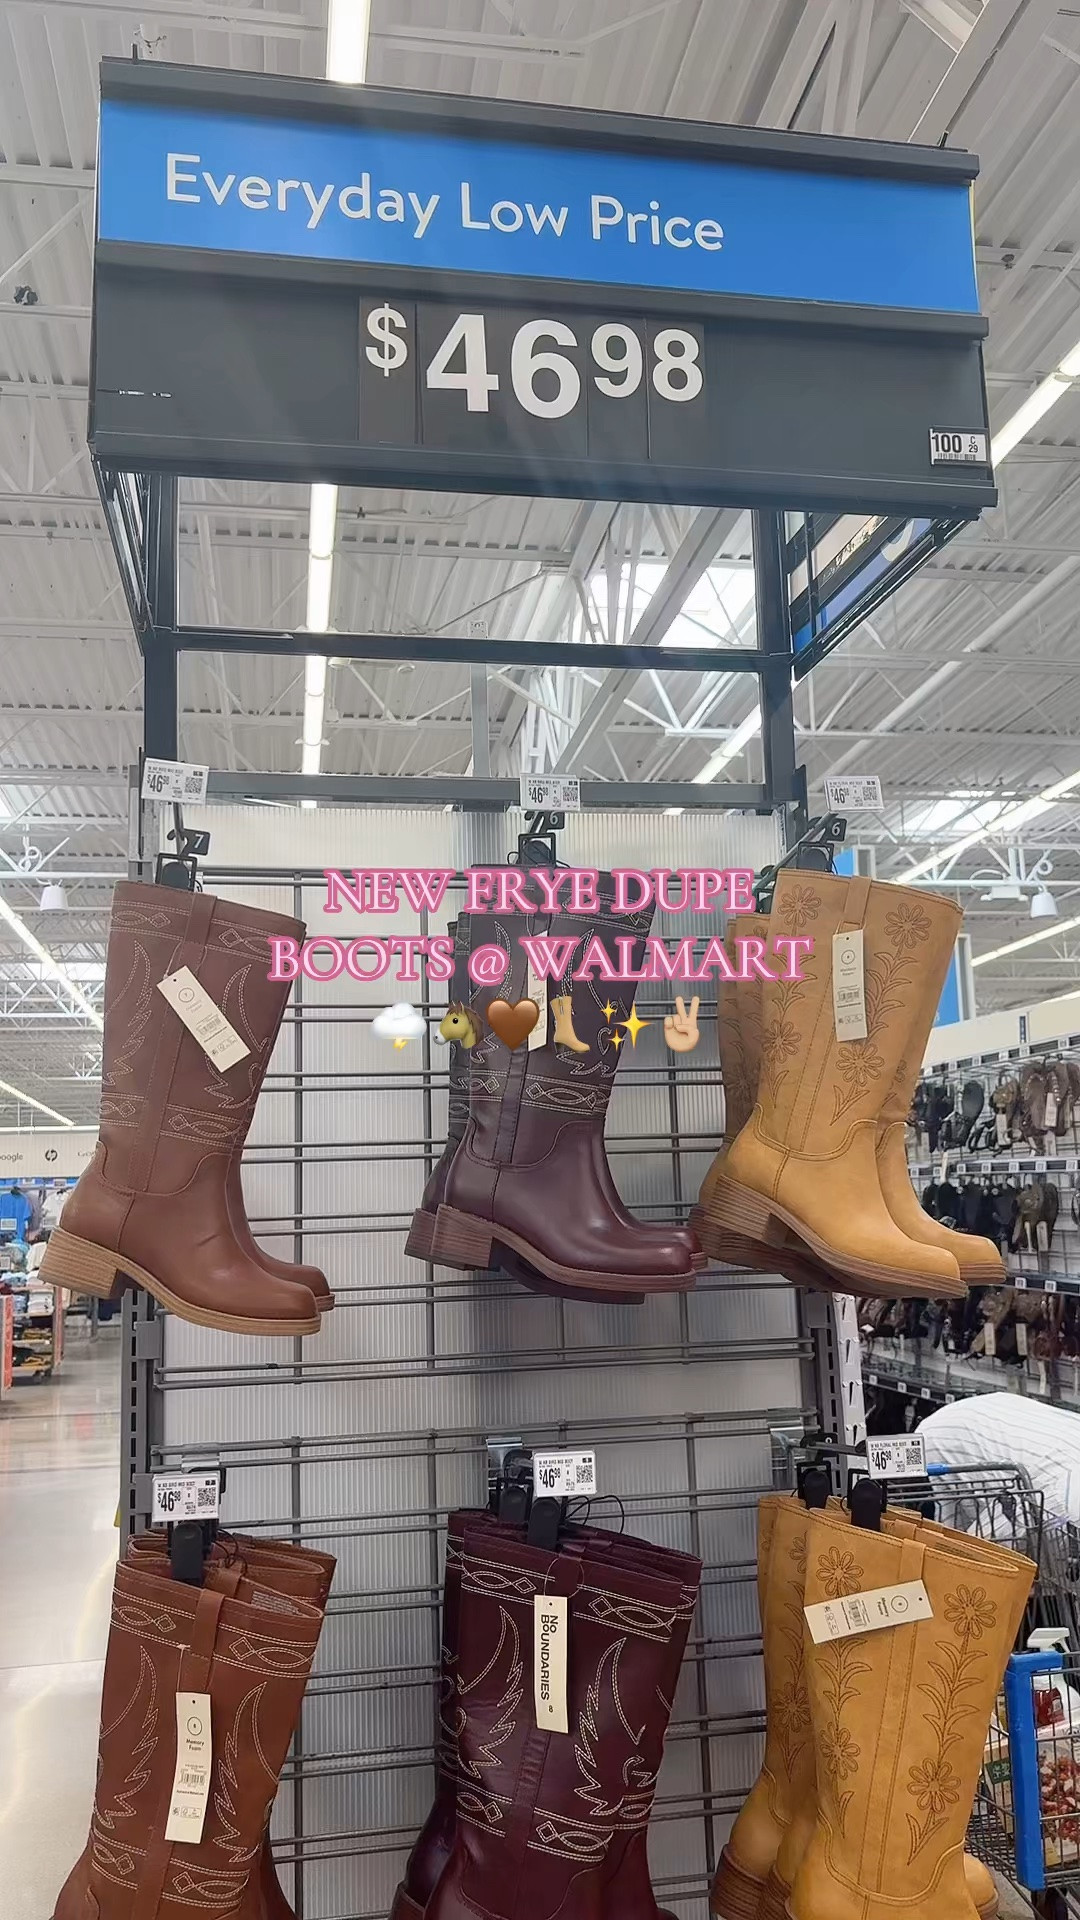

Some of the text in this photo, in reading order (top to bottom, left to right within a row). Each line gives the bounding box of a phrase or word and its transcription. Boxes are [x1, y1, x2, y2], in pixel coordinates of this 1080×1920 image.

[165, 152, 725, 251] Everyday Low Price
[932, 434, 962, 453] 100
[970, 436, 977, 445] C
[968, 444, 979, 453] 29
[550, 811, 559, 825] 6
[831, 822, 841, 836] 6
[194, 833, 205, 849] 7
[0, 1151, 24, 1163] oogle
[550, 1615, 558, 1633] NO
[540, 1614, 550, 1700] BOUNDARIES
[548, 1705, 554, 1713] 8
